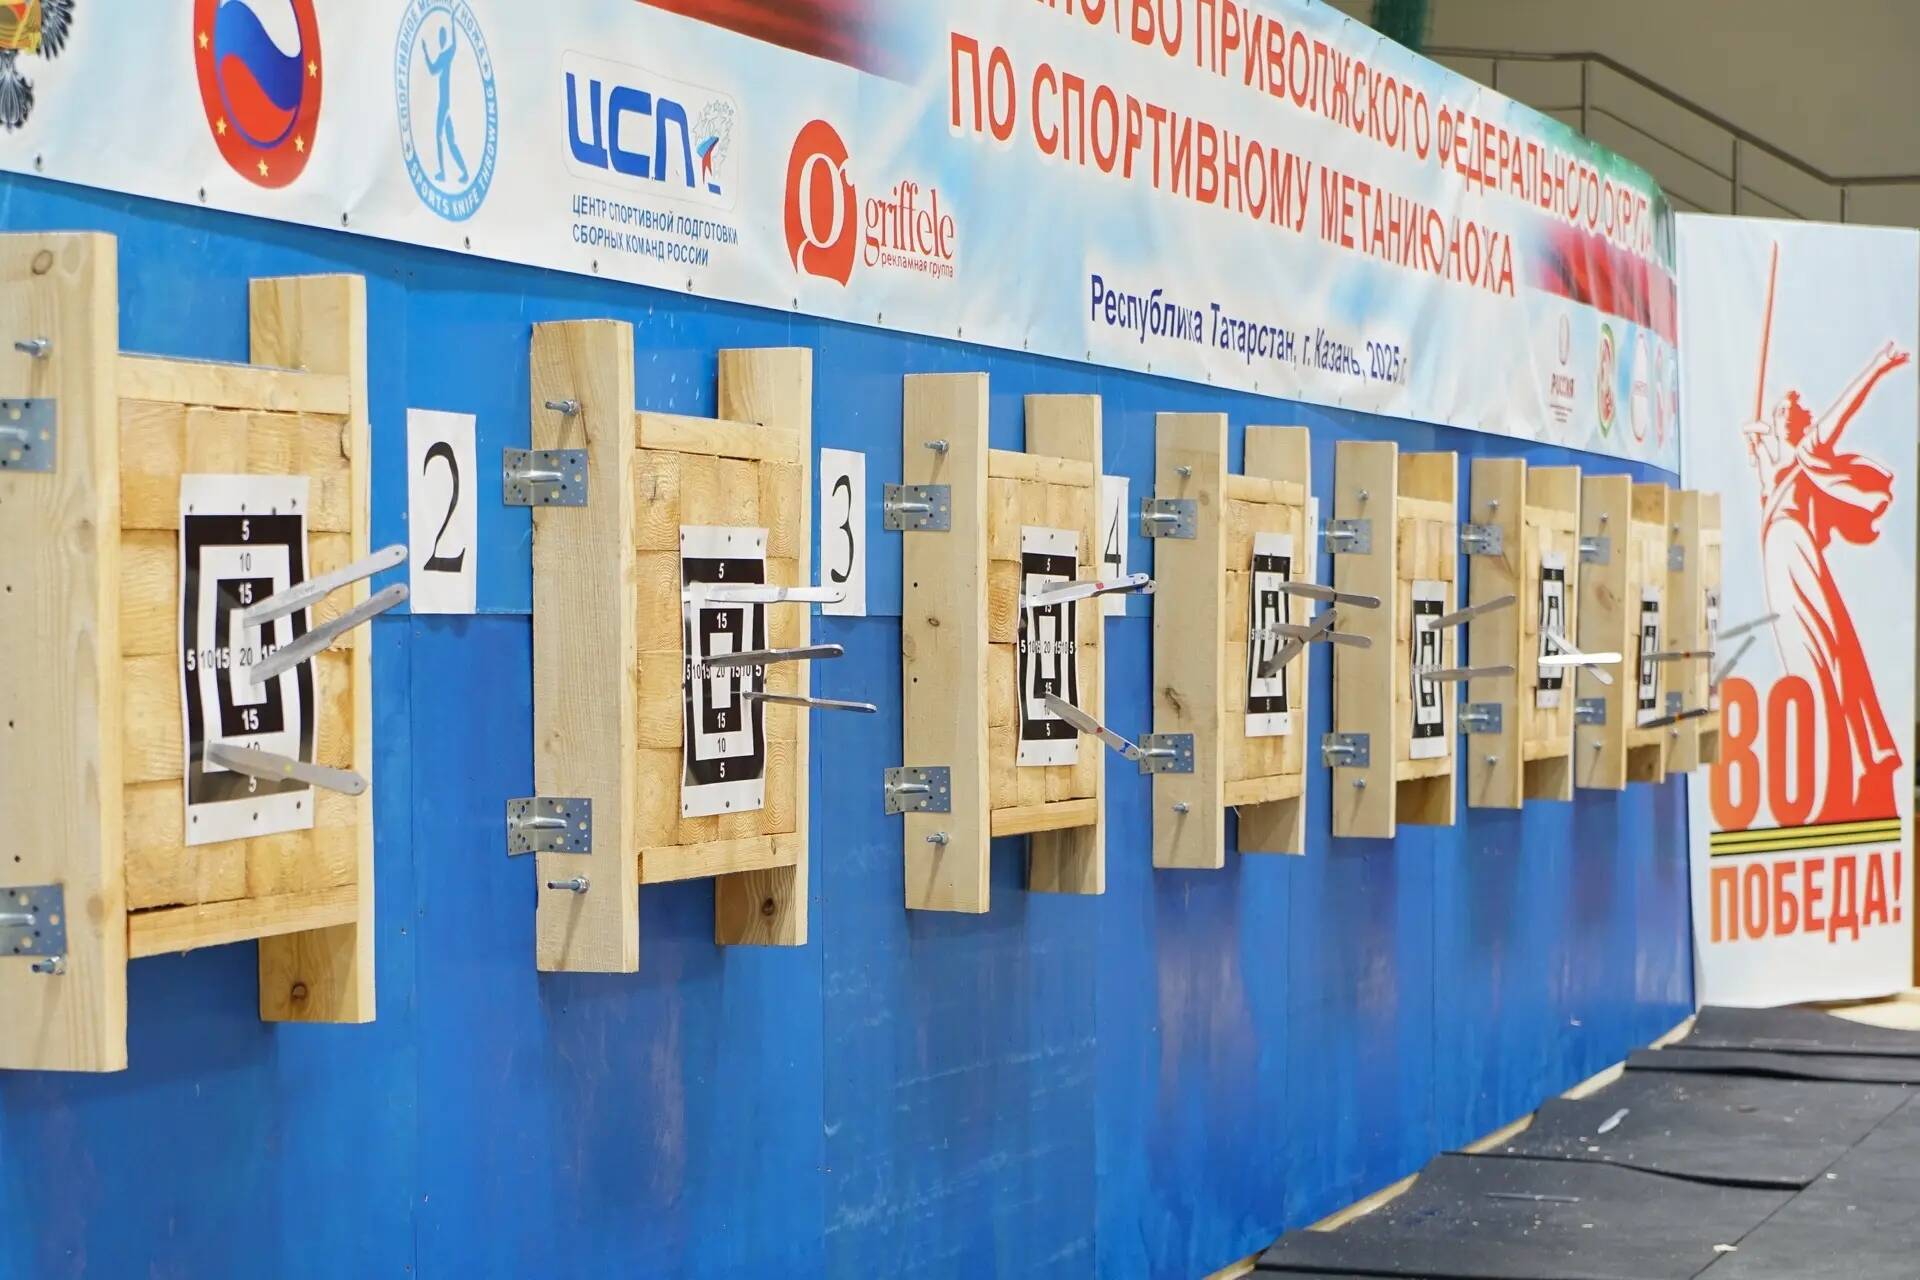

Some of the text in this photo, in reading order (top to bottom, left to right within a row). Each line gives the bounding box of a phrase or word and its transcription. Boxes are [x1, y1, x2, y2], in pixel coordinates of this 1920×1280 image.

[1197, 0, 1430, 160] ПРИВОЛЖСКОГО
[951, 31, 1016, 141] ПО
[1032, 62, 1313, 234] СПОРТИВНОМУ
[1320, 166, 1445, 275] МЕТАНИЮ
[411, 161, 450, 216] SPORTS
[452, 187, 480, 217] KNIFE
[572, 194, 738, 245] ЦЕНТР СПОРТИВНОЙ ПОДГОТОВКИ
[864, 180, 954, 267] griffele
[572, 223, 710, 267] СБОРНЫХ КОМАНД РОССИИ
[881, 253, 954, 279] рекламная группа
[1091, 274, 1203, 345] Республика
[1210, 302, 1298, 370] Татарстан,
[423, 441, 466, 572] 2
[241, 519, 250, 541] 5
[831, 474, 854, 583] 3
[1104, 496, 1121, 578] 4
[239, 552, 252, 572] 10
[719, 562, 725, 580] 5
[1046, 558, 1051, 571] 5
[238, 581, 252, 605] 15
[716, 612, 727, 629] 15
[1020, 639, 1026, 654] 5
[1044, 640, 1051, 653] 20
[1054, 640, 1062, 654] 15
[1069, 641, 1074, 654] 5
[187, 648, 196, 671] 5
[201, 649, 214, 669] 10
[215, 647, 230, 669] 15
[239, 647, 253, 666] 20
[686, 663, 762, 680] 5 10 15 20 15 10 5
[241, 708, 259, 731] 15
[717, 711, 727, 729] 15
[1046, 723, 1051, 736] 5
[717, 737, 726, 753] 10
[1709, 675, 1816, 832] 80
[719, 762, 725, 779] 5
[1710, 851, 1903, 944] ПОБЕДА!
